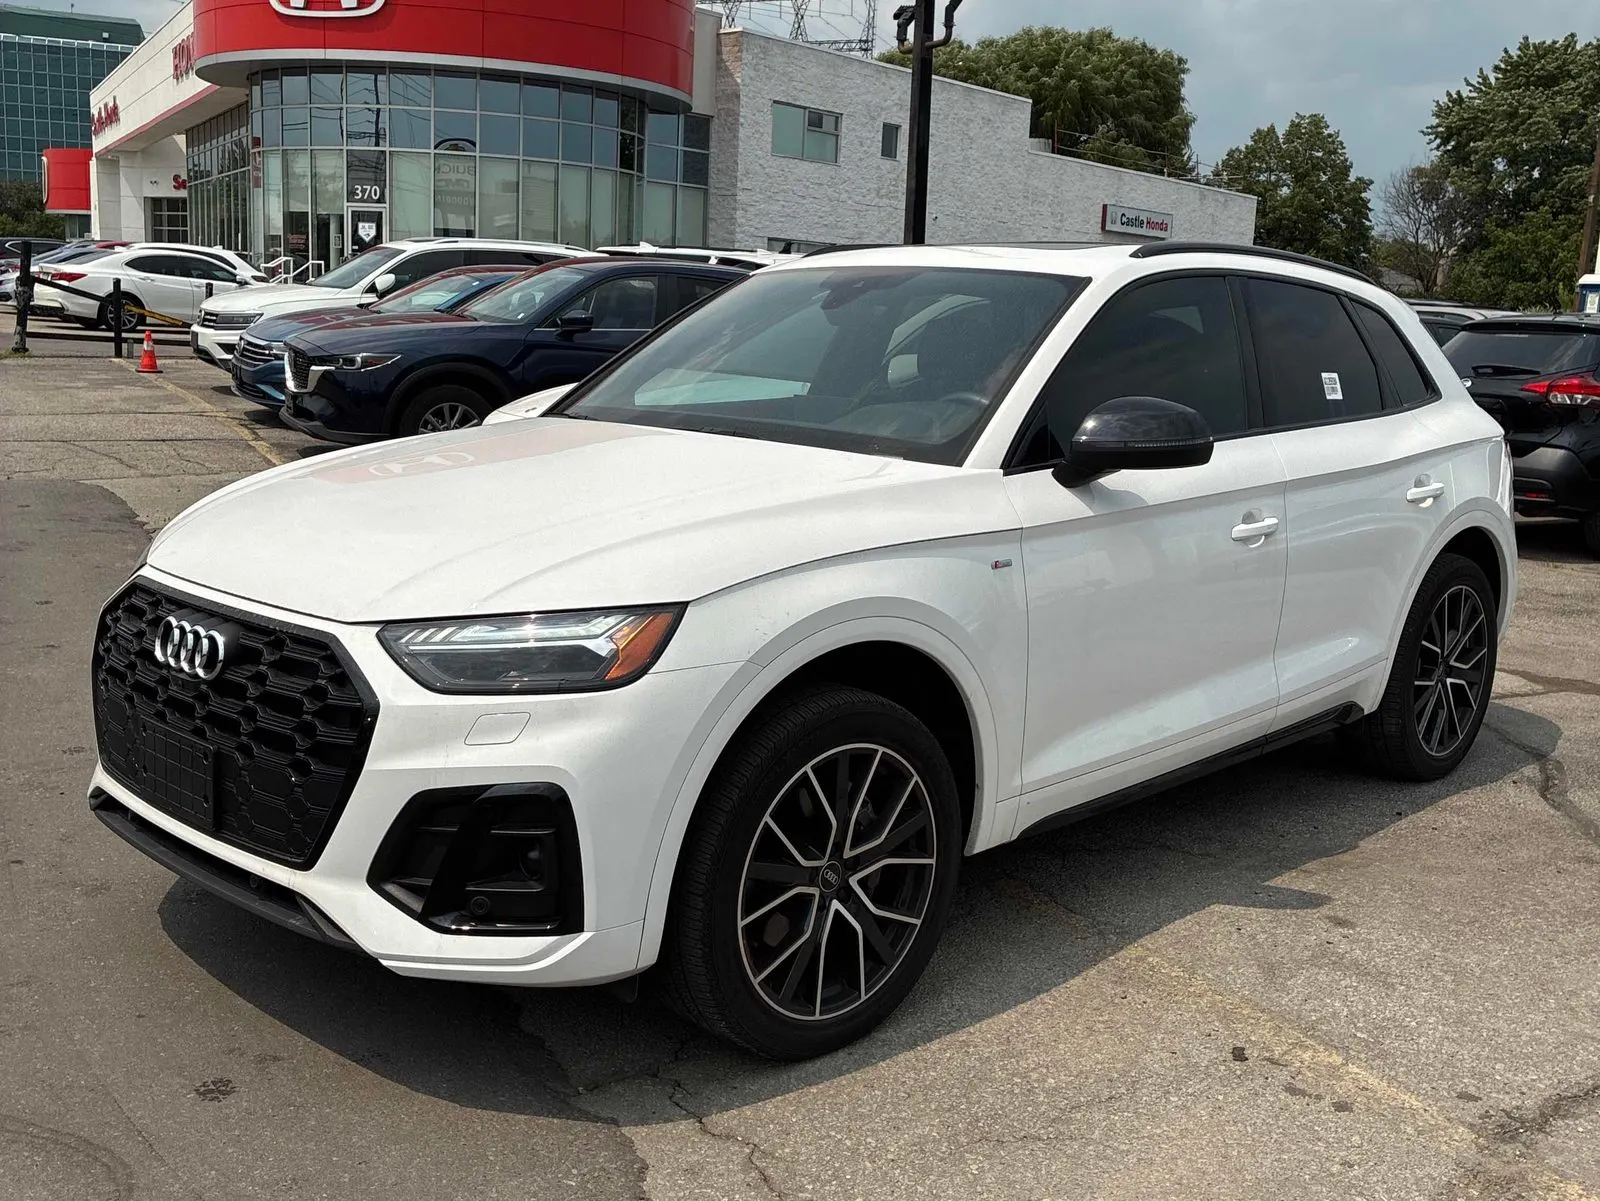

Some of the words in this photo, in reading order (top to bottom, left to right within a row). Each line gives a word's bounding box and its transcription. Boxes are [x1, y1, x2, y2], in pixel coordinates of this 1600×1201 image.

[354, 185, 380, 200] 370
[1120, 213, 1145, 229] Castle
[1145, 216, 1169, 232] Honda
